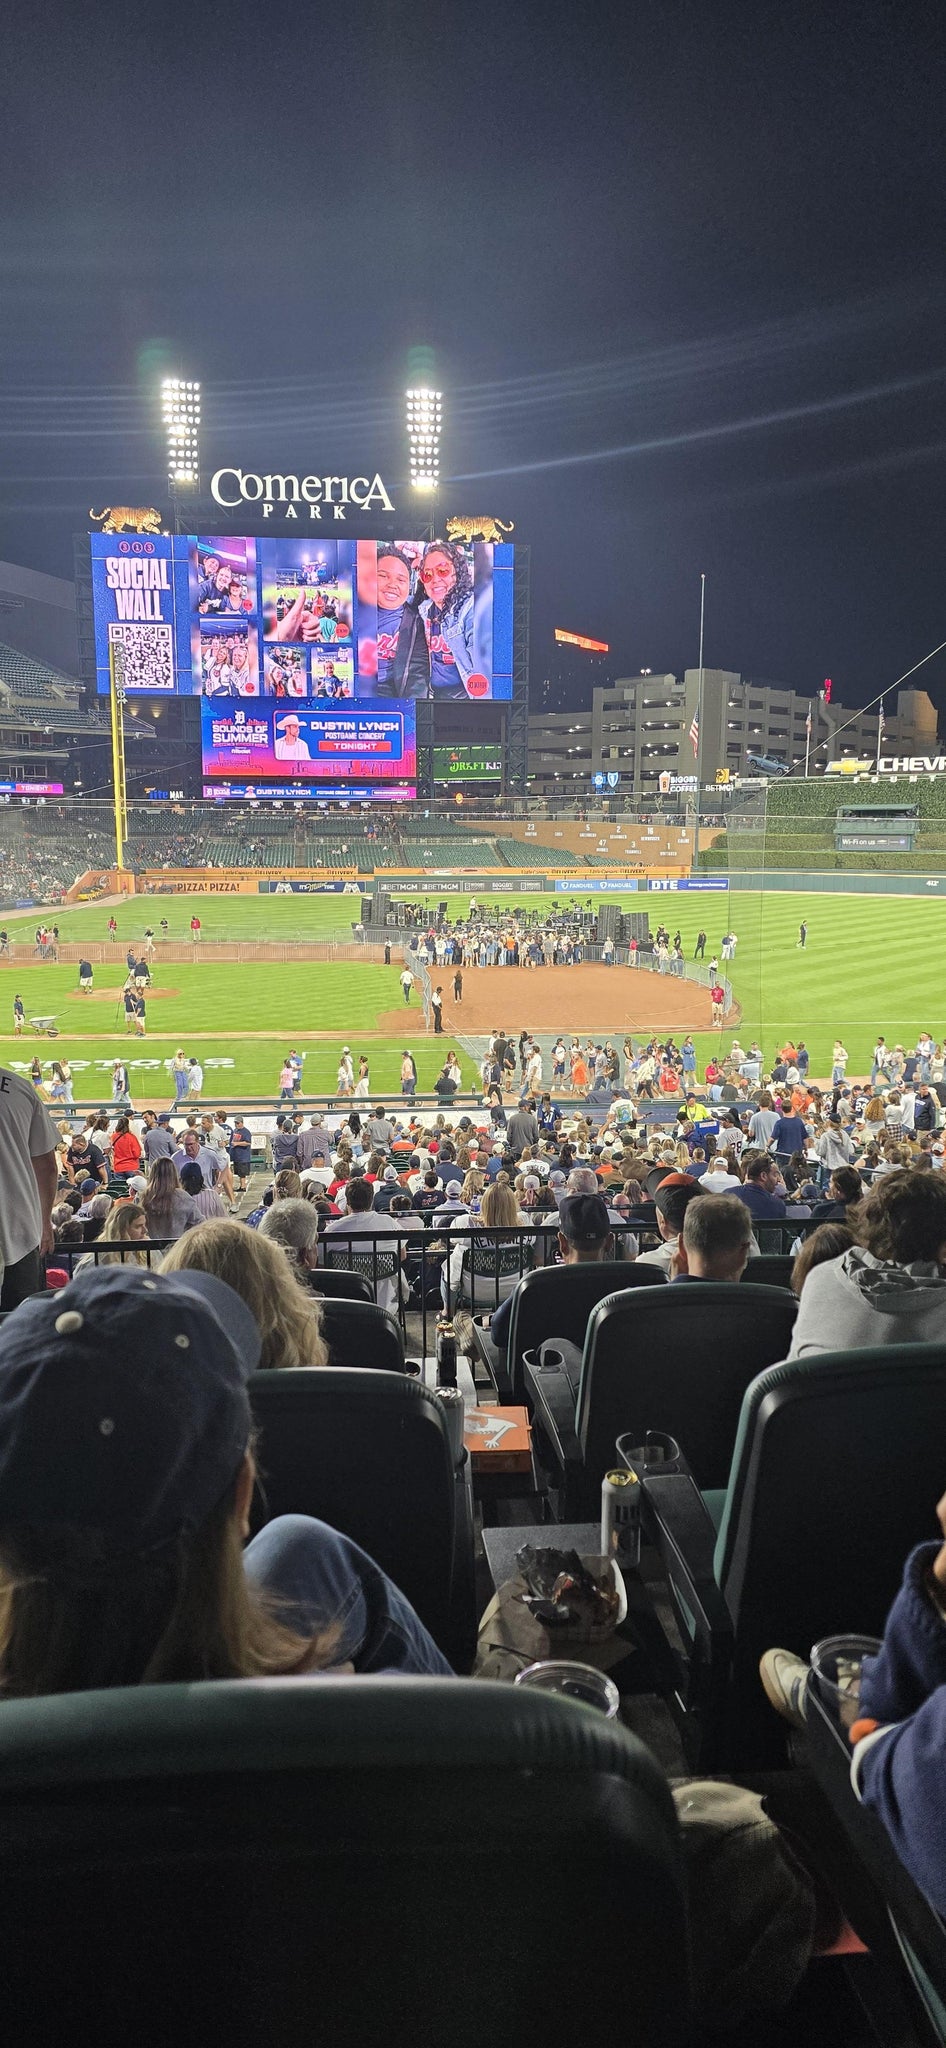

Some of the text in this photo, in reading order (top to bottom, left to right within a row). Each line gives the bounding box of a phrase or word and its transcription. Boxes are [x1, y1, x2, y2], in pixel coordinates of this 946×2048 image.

[262, 503, 346, 519] PARK
[106, 557, 171, 590] SOCIAL
[115, 589, 164, 621] WALL
[212, 724, 268, 734] SOUNDS OF
[310, 721, 399, 731] DUSTIN LYNCH
[212, 733, 269, 744] SUMMER
[324, 732, 386, 740] POSTGAME CONCERT
[527, 823, 535, 831] 23
[585, 823, 591, 831] 5
[616, 825, 621, 833] 2
[647, 827, 654, 835] 16
[598, 839, 607, 847] 47
[631, 841, 636, 849] 3
[177, 882, 240, 892] PIZZA! PIZZA!
[651, 880, 678, 890] DTE
[0, 1076, 12, 1094] E
